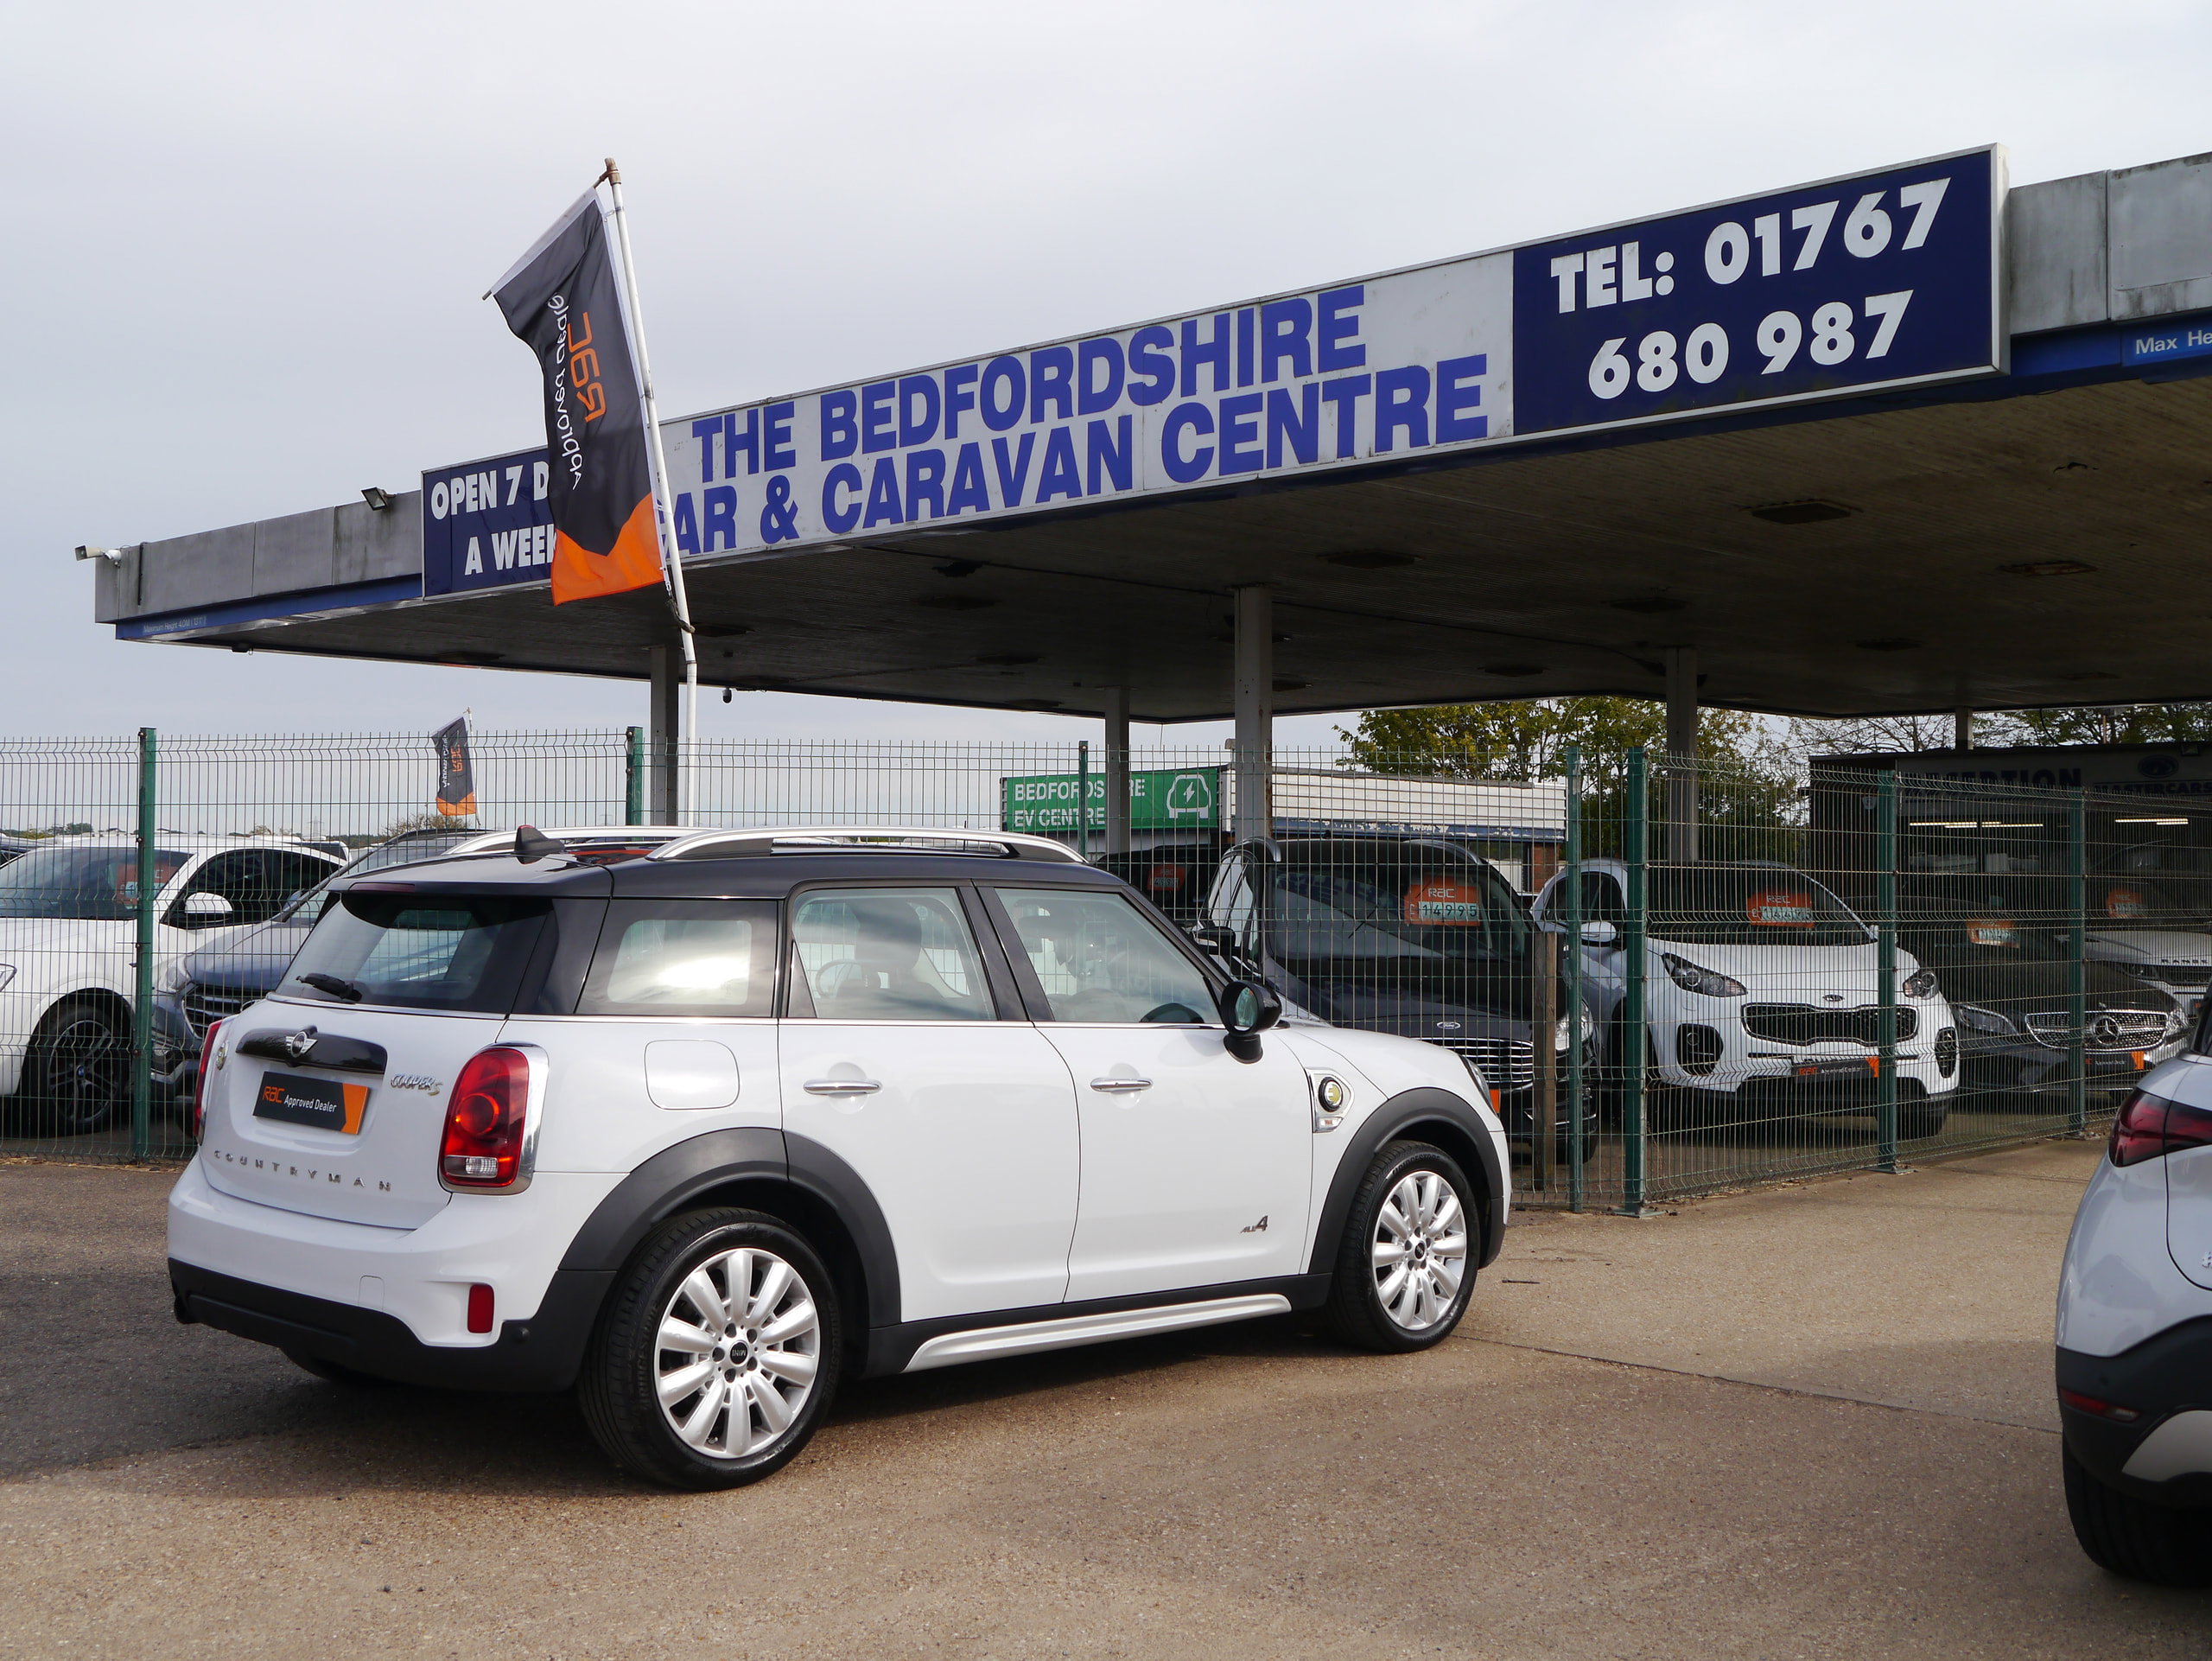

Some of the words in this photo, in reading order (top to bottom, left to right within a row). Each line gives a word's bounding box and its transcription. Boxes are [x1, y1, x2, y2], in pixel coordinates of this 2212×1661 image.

[1550, 240, 1675, 314] TEL:
[1704, 177, 1951, 285] 01767
[1588, 322, 1729, 400] 680
[1756, 290, 1914, 375] 987
[2135, 337, 2178, 354] Max
[692, 401, 796, 483] THE
[820, 284, 1366, 461] BEDFORDSHIRE
[658, 486, 737, 558] AR
[760, 476, 799, 545] &
[822, 415, 1133, 534] CARAVAN
[1161, 353, 1488, 483] CENTRE
[431, 470, 498, 520] OPEN
[505, 464, 524, 506] 7
[464, 536, 484, 576] A
[1014, 809, 1034, 828] EV
[283, 1094, 315, 1110] Approved
[315, 1098, 337, 1113] Dealer
[214, 1150, 391, 1192] COUNTRYMAN
